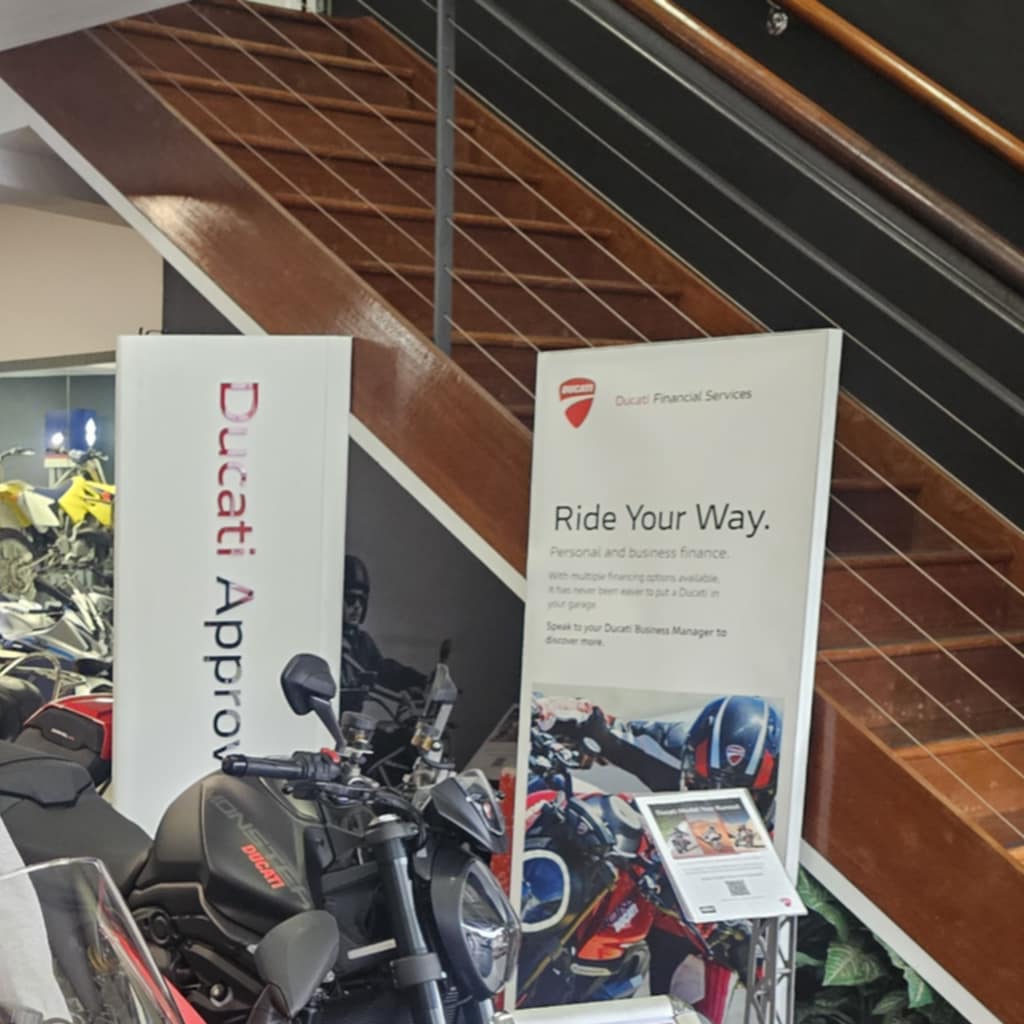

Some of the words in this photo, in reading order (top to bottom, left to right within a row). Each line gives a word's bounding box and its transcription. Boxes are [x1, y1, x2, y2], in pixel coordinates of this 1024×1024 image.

[615, 394, 650, 407] Ducati
[653, 391, 702, 404] Financial
[705, 388, 753, 402] Services
[216, 382, 260, 556] Ducati
[554, 504, 617, 531] Ride
[626, 504, 687, 531] Your
[696, 503, 770, 538] Way.
[549, 546, 602, 559] Personal
[604, 546, 626, 559] and
[628, 546, 677, 559] business
[546, 621, 571, 633] Speak
[584, 624, 602, 634] your
[604, 622, 632, 634] Ducati
[634, 624, 670, 636] Business
[671, 625, 714, 640] Manager
[203, 576, 255, 762] Approv
[240, 844, 285, 889] DUCATI
